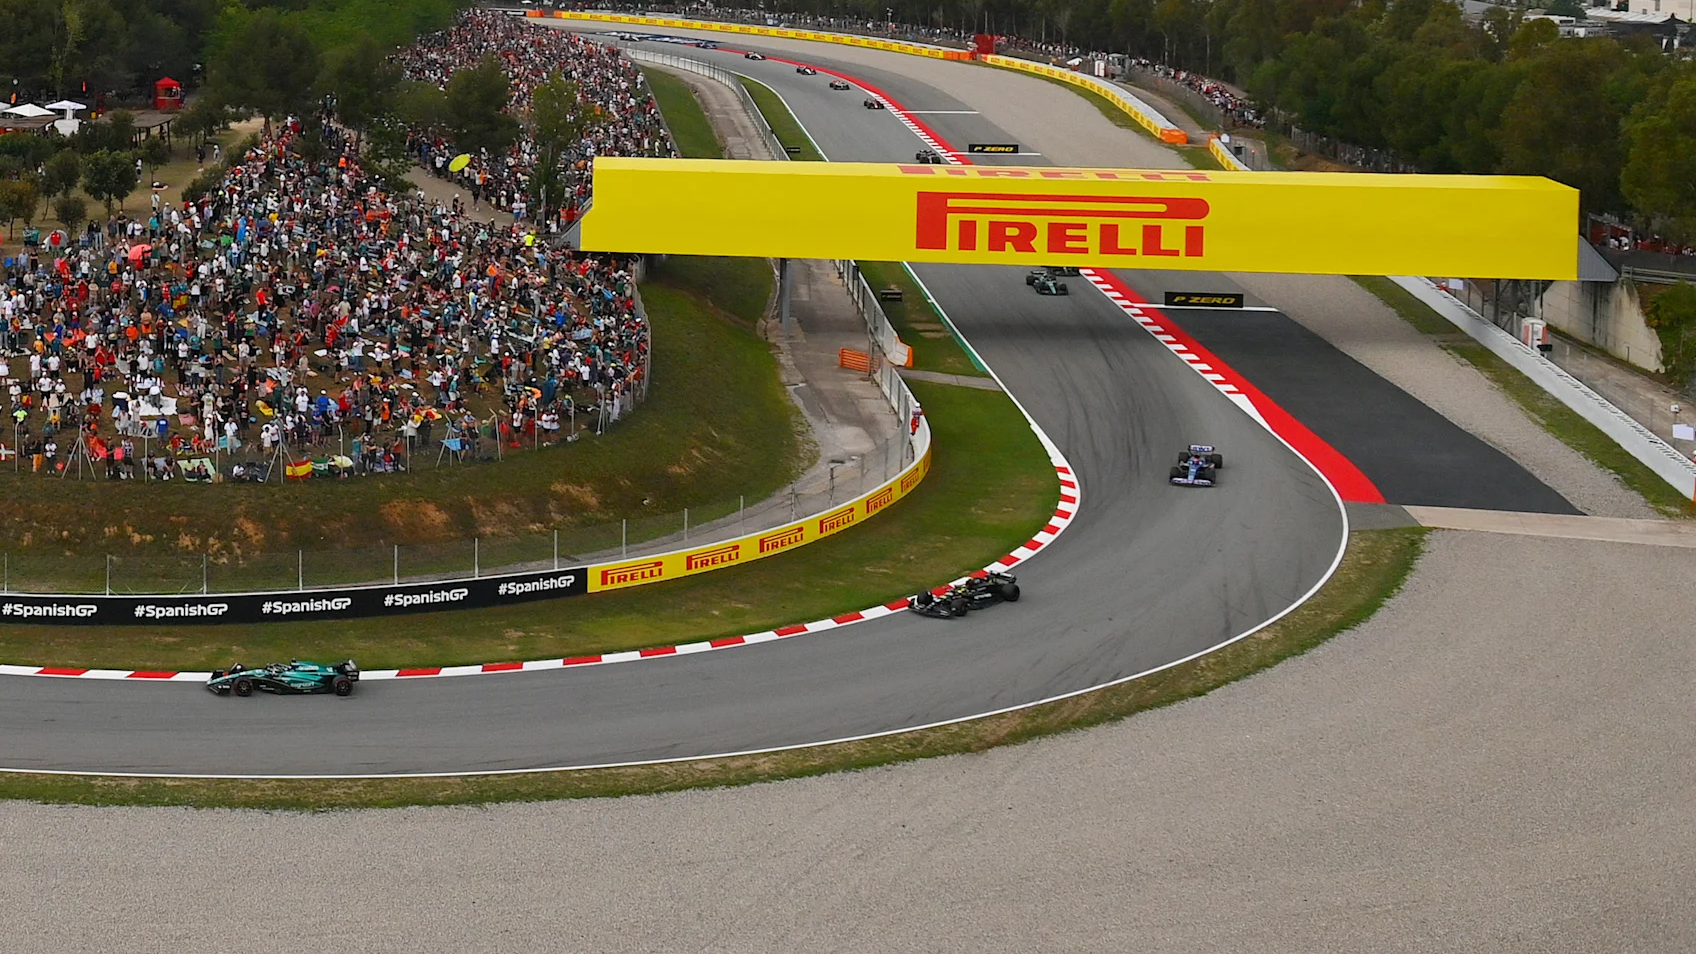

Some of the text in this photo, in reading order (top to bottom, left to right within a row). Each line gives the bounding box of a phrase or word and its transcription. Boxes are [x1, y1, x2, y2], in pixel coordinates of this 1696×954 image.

[915, 191, 1211, 257] PIRELLI
[1173, 295, 1236, 304] P ZERO
[866, 487, 893, 514] PIRELLI
[820, 507, 855, 534] PIRELLI
[759, 526, 804, 553] PIRELLI
[686, 544, 740, 571] PIRELLI
[600, 561, 663, 586] PIRELLI
[499, 575, 575, 595] #SpanishGP
[262, 598, 351, 615] #SpanishGP
[384, 588, 468, 606] #SpanishGP
[2, 603, 97, 618] #SpanishGP
[135, 604, 228, 619] #SpanishGP
